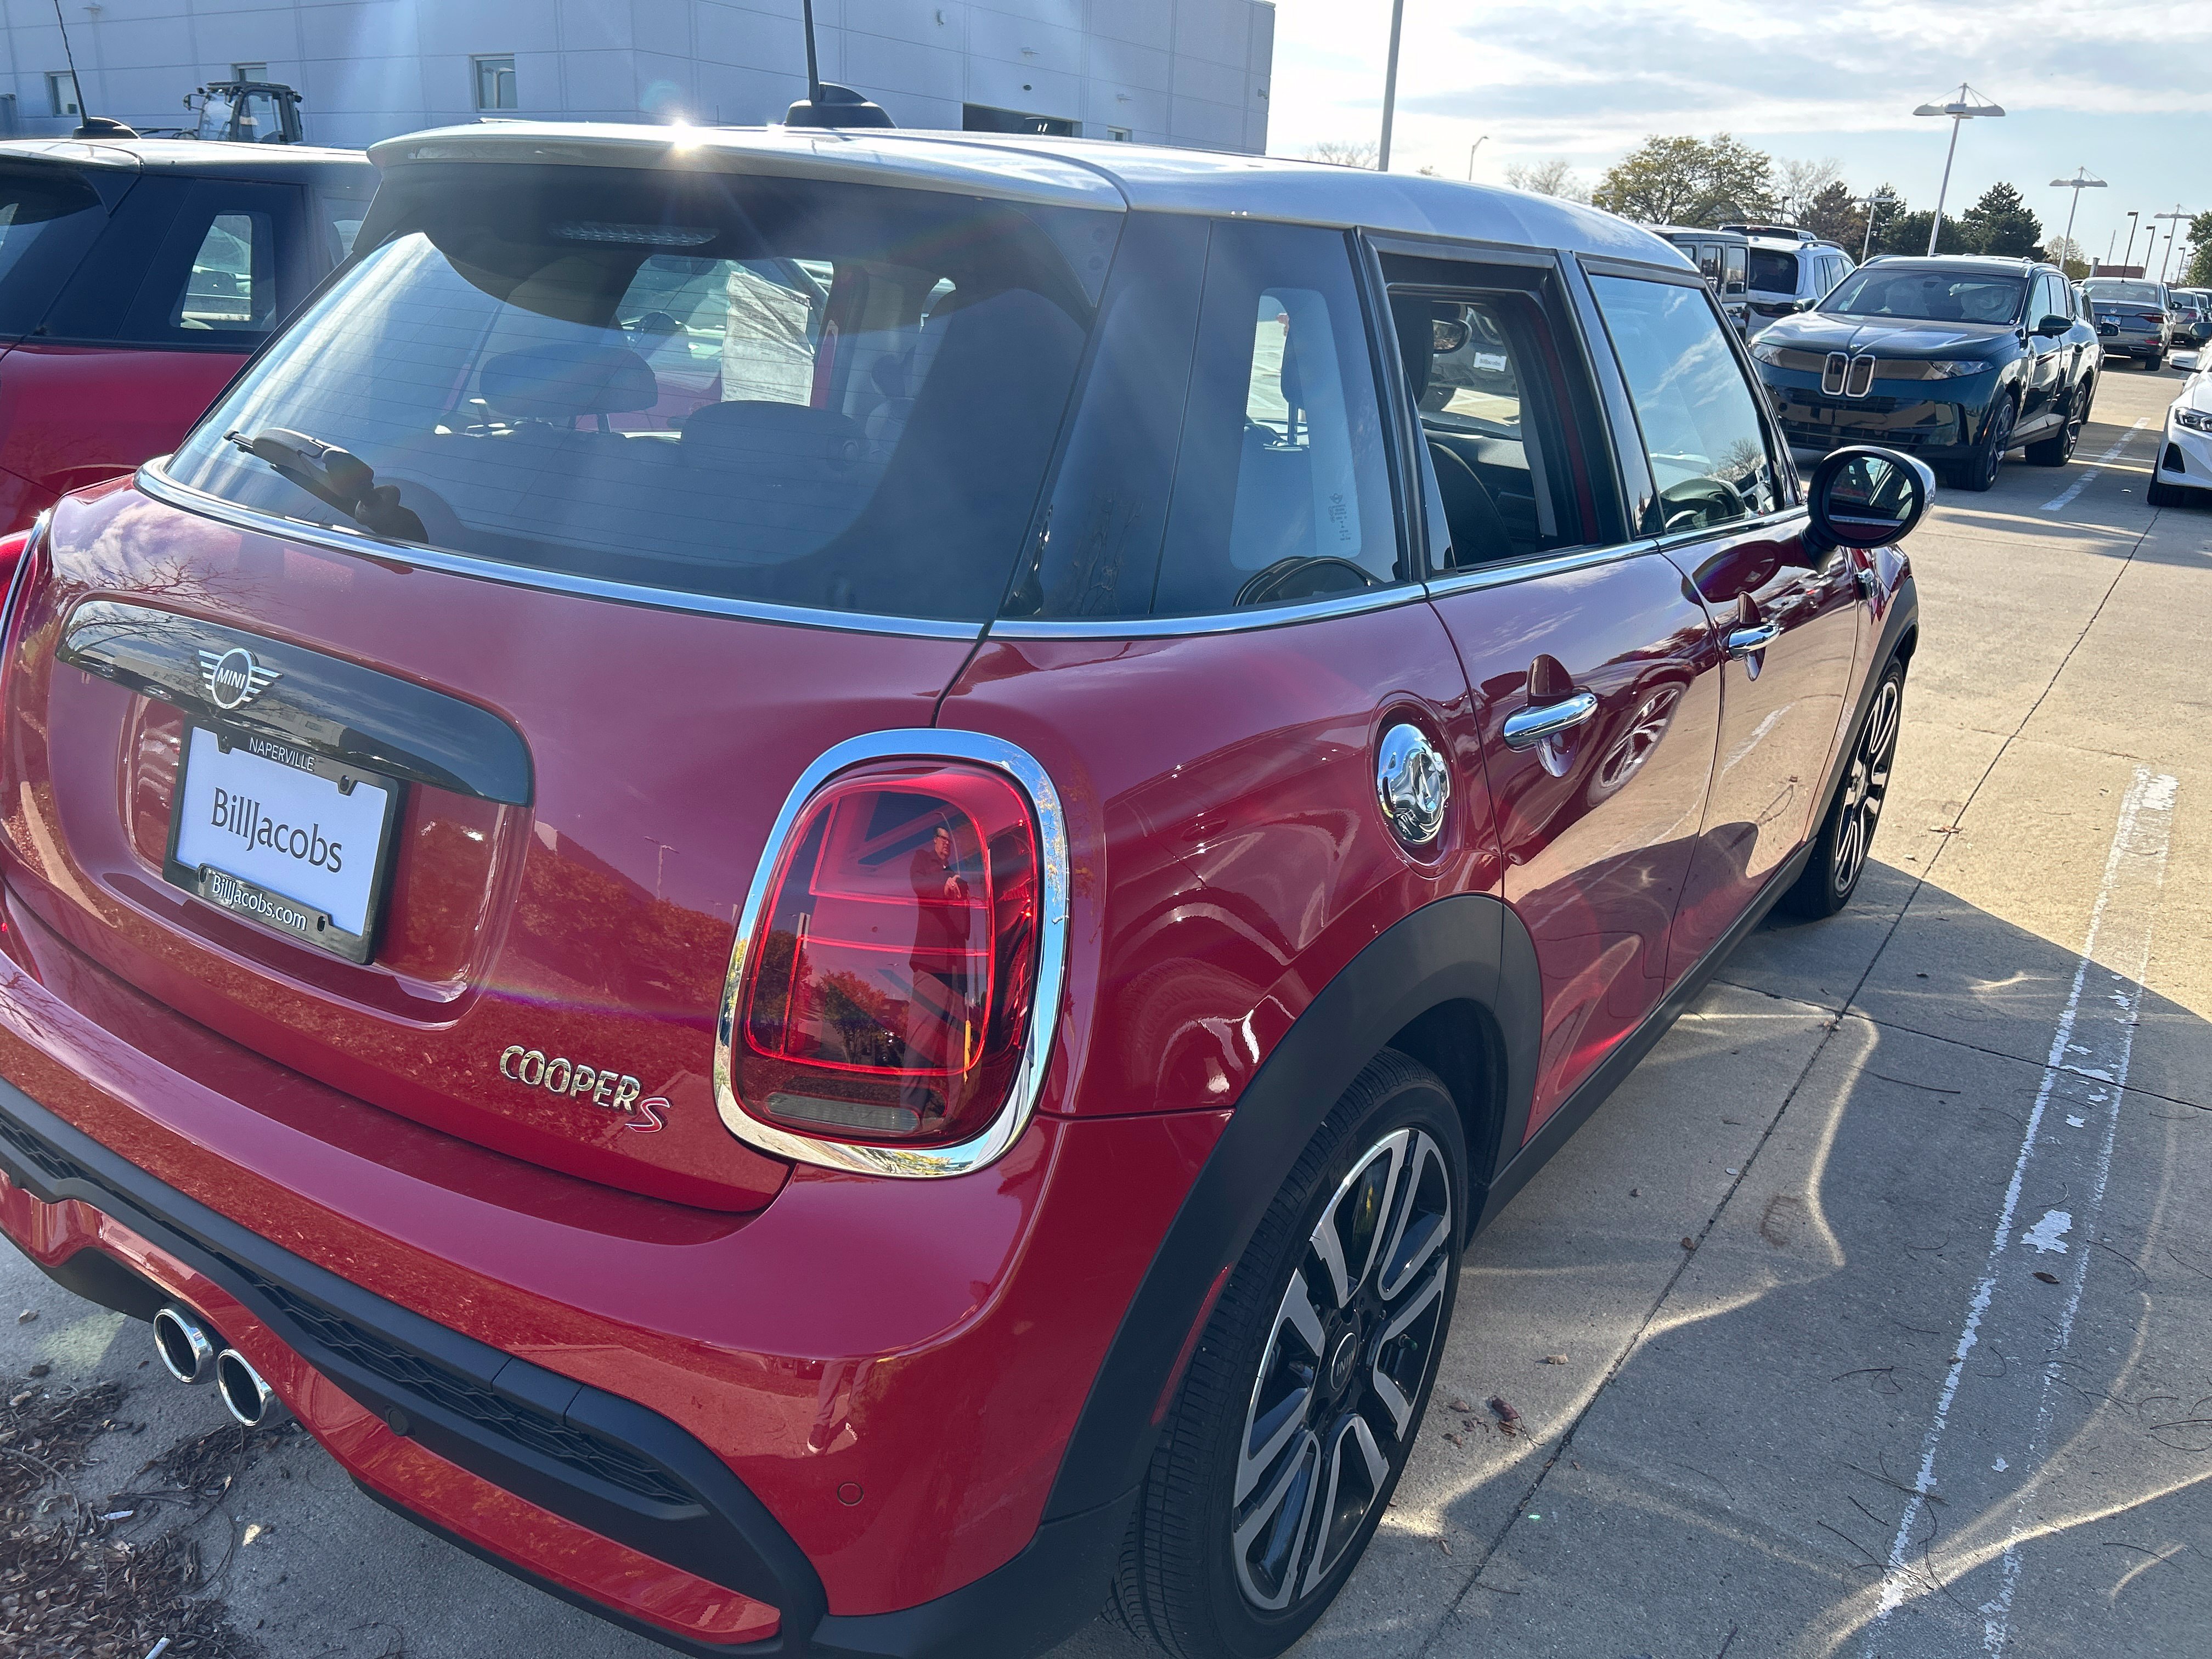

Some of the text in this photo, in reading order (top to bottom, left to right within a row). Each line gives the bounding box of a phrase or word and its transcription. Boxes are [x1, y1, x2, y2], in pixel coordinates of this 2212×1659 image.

[217, 667, 246, 689] MINI
[249, 737, 315, 771] NAPERVILLE
[212, 874, 307, 930] BillJacobs.com
[499, 1045, 671, 1133] COOPER S
